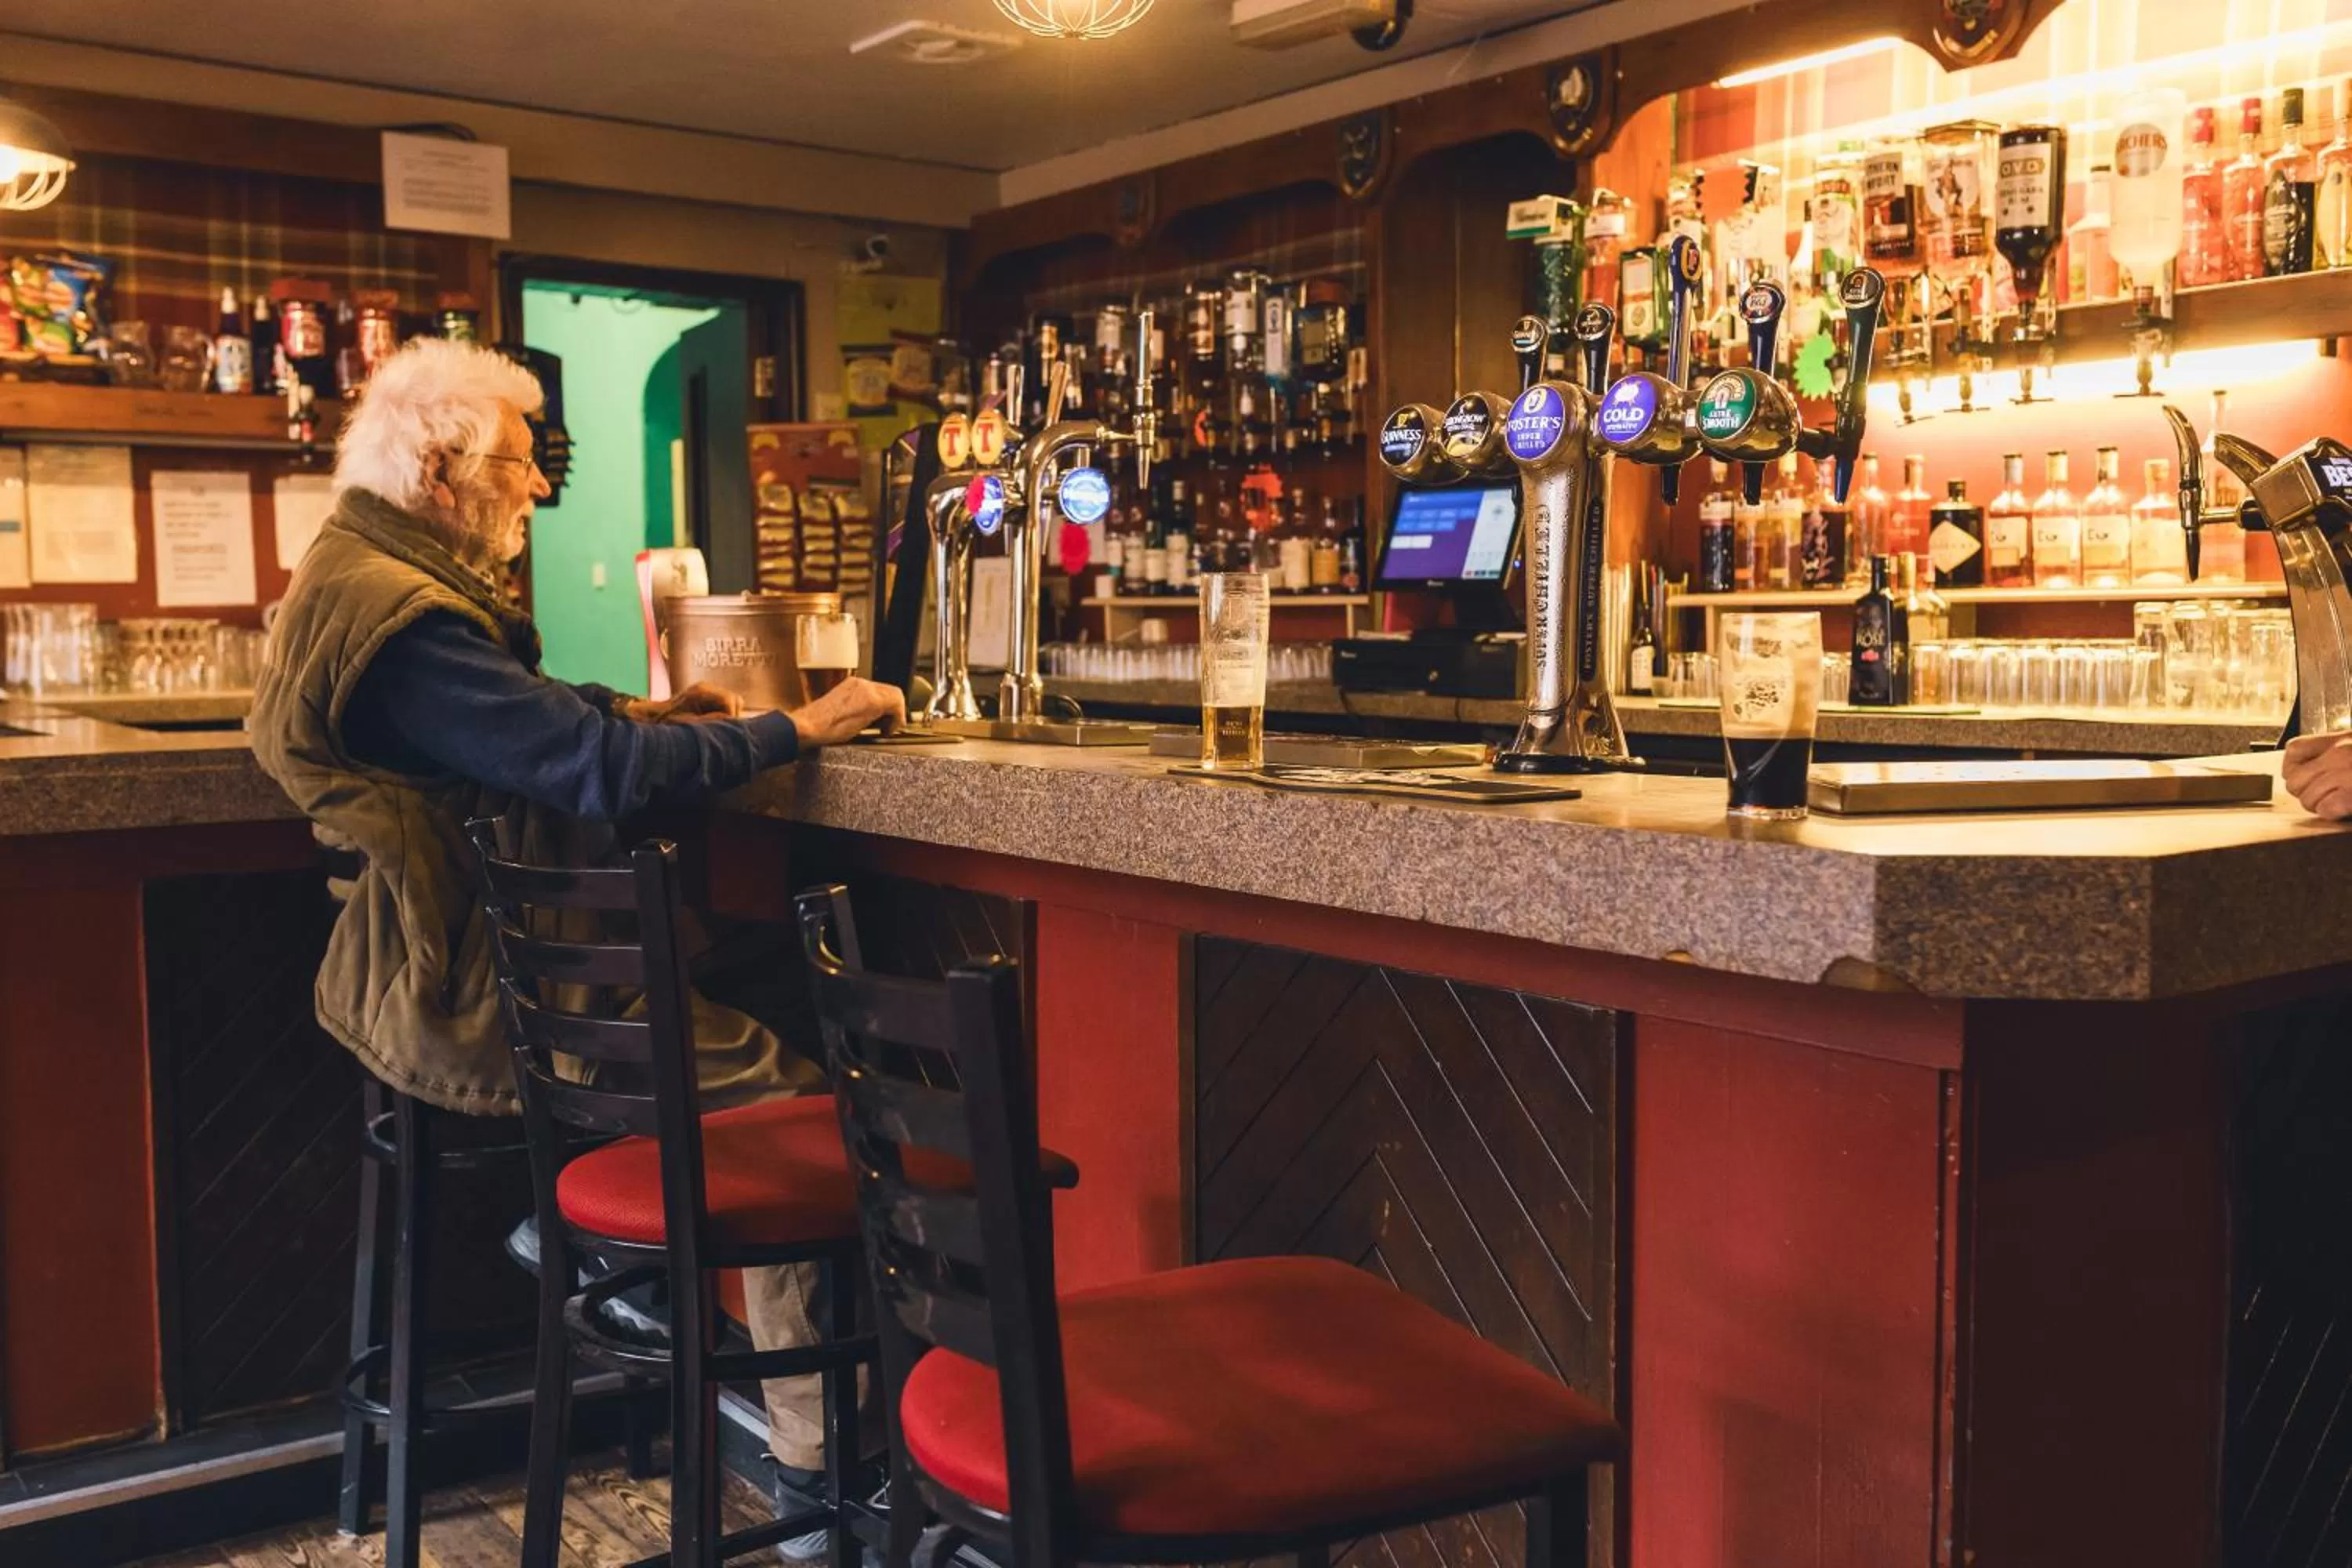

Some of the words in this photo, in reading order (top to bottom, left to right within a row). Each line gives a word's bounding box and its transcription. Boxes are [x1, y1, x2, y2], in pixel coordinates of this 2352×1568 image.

[1603, 407, 1644, 423] COLD
[1508, 416, 1561, 431] FOSTER'S
[1702, 416, 1739, 430] SMOOTH
[943, 426, 960, 456] T
[978, 423, 994, 452] T
[1381, 429, 1422, 444] GUINNESS
[706, 637, 762, 652] BIRRA
[693, 652, 777, 667] MORETTI
